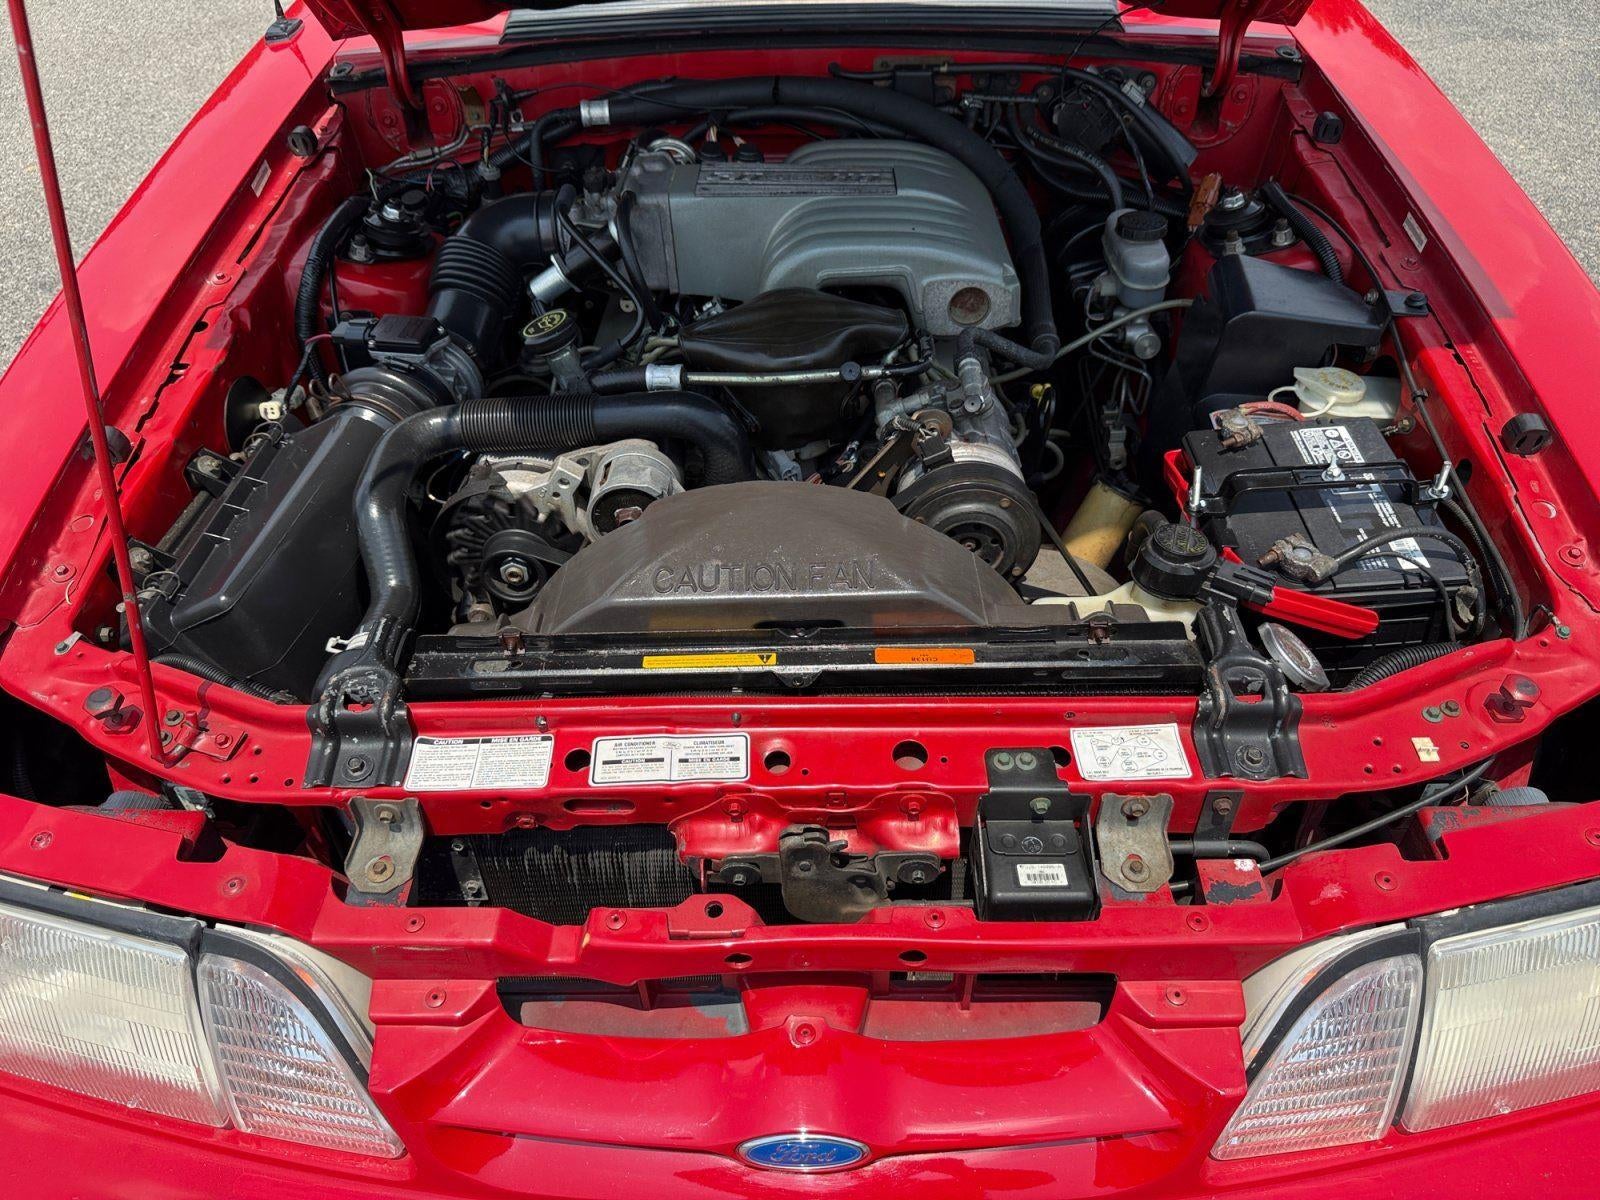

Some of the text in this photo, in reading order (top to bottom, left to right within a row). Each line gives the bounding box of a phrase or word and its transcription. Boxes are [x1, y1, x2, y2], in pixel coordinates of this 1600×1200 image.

[652, 561, 876, 594] CAUTION FAN
[769, 1143, 837, 1163] Ford
